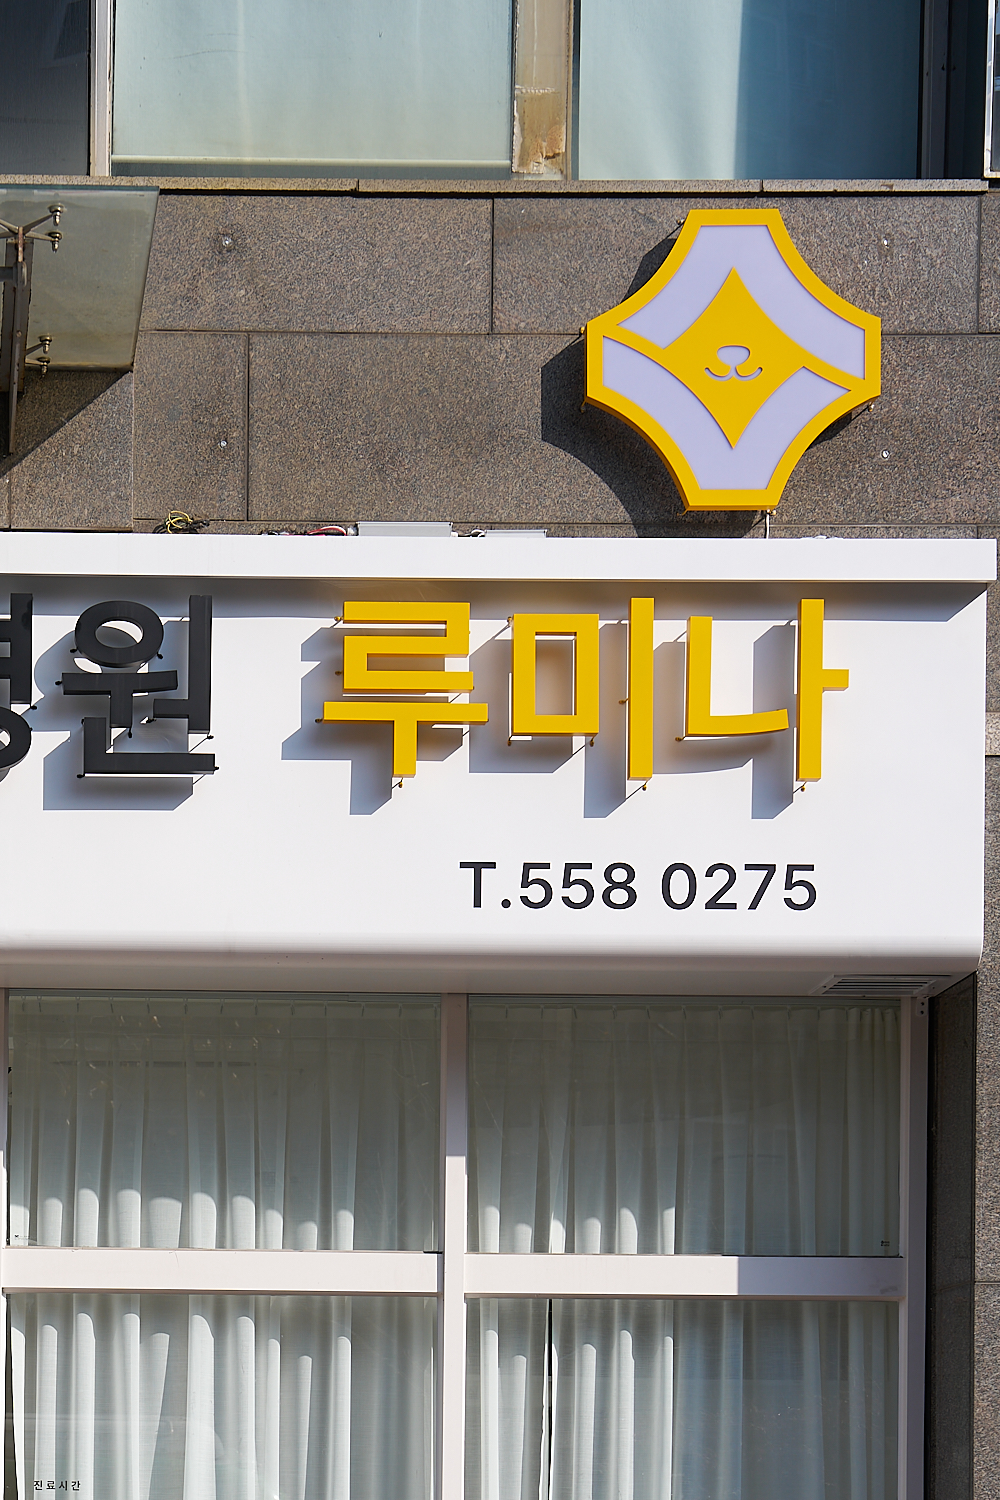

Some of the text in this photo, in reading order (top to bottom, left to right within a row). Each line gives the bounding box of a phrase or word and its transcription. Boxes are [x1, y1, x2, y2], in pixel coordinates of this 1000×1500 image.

[322, 597, 850, 782] 루미나
[460, 861, 817, 911] T.558 0275
[33, 1480, 81, 1491] 진료시간
